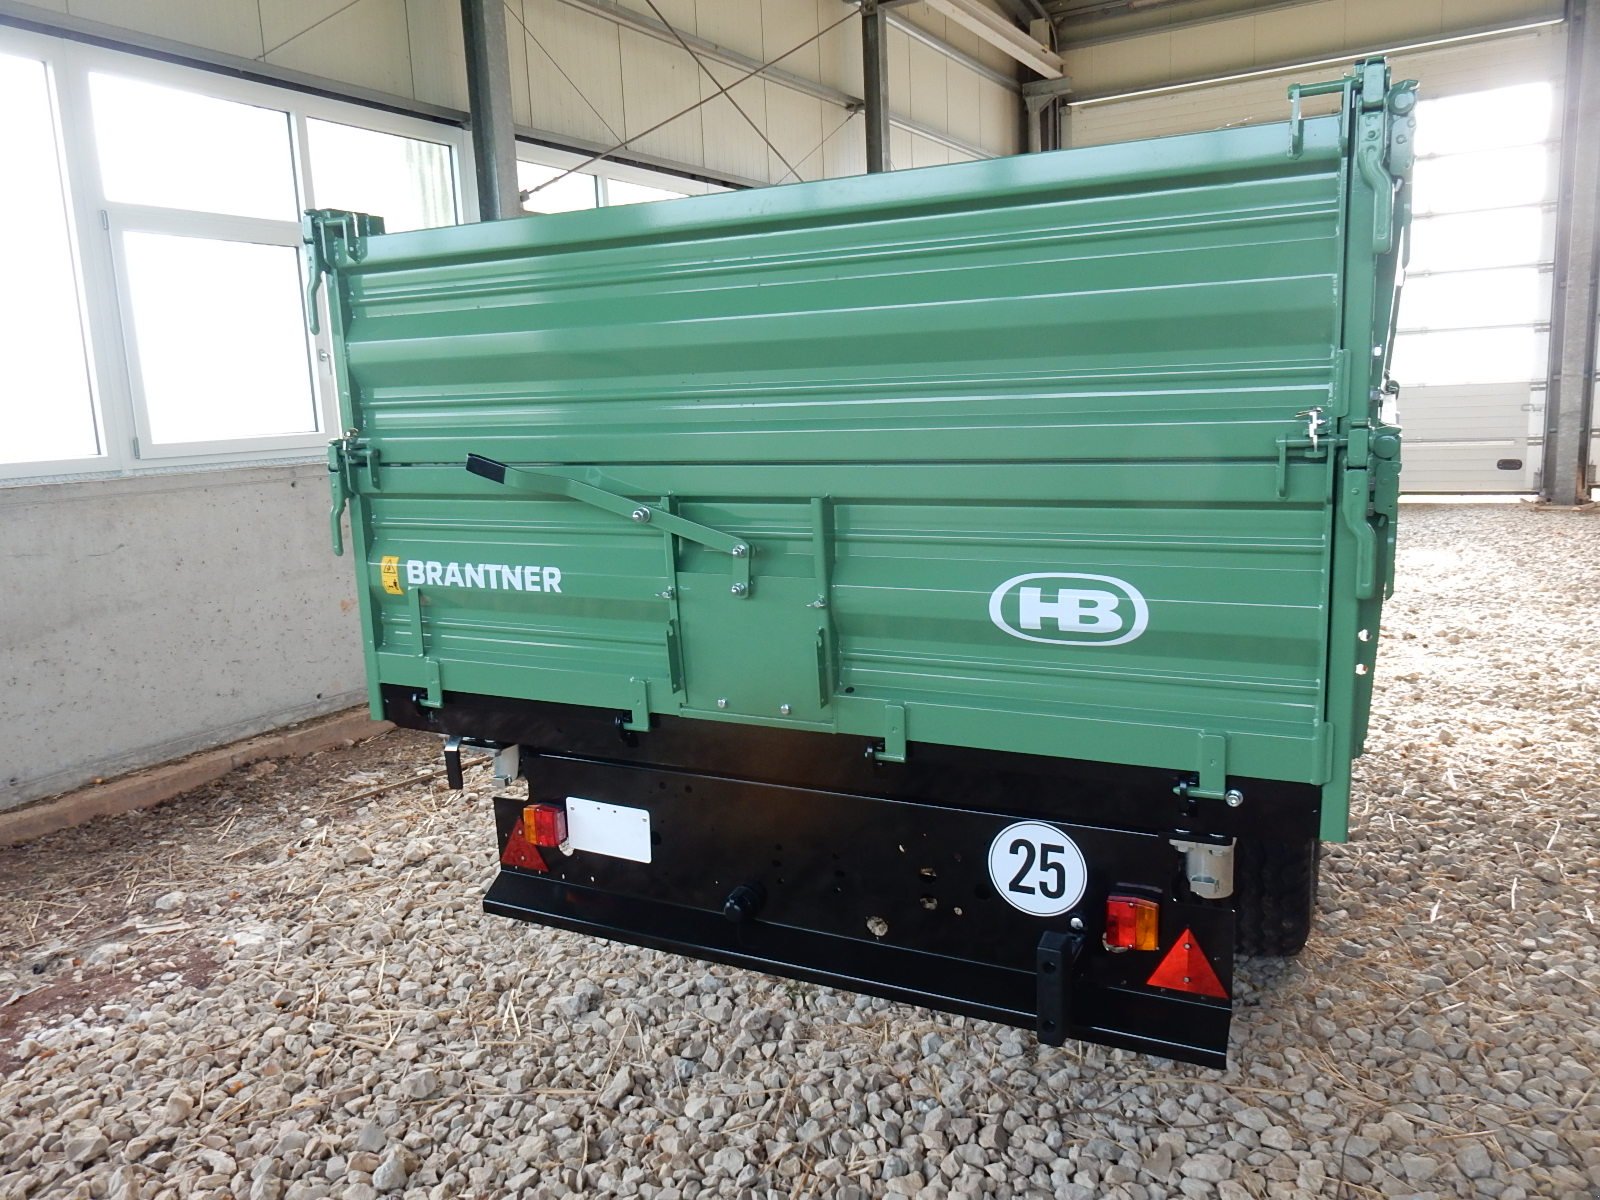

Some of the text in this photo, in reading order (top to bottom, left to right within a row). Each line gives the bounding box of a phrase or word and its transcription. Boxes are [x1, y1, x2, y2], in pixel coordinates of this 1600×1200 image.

[406, 559, 562, 593] BRANTNER
[1020, 586, 1123, 634] HB
[1007, 837, 1066, 900] 25
